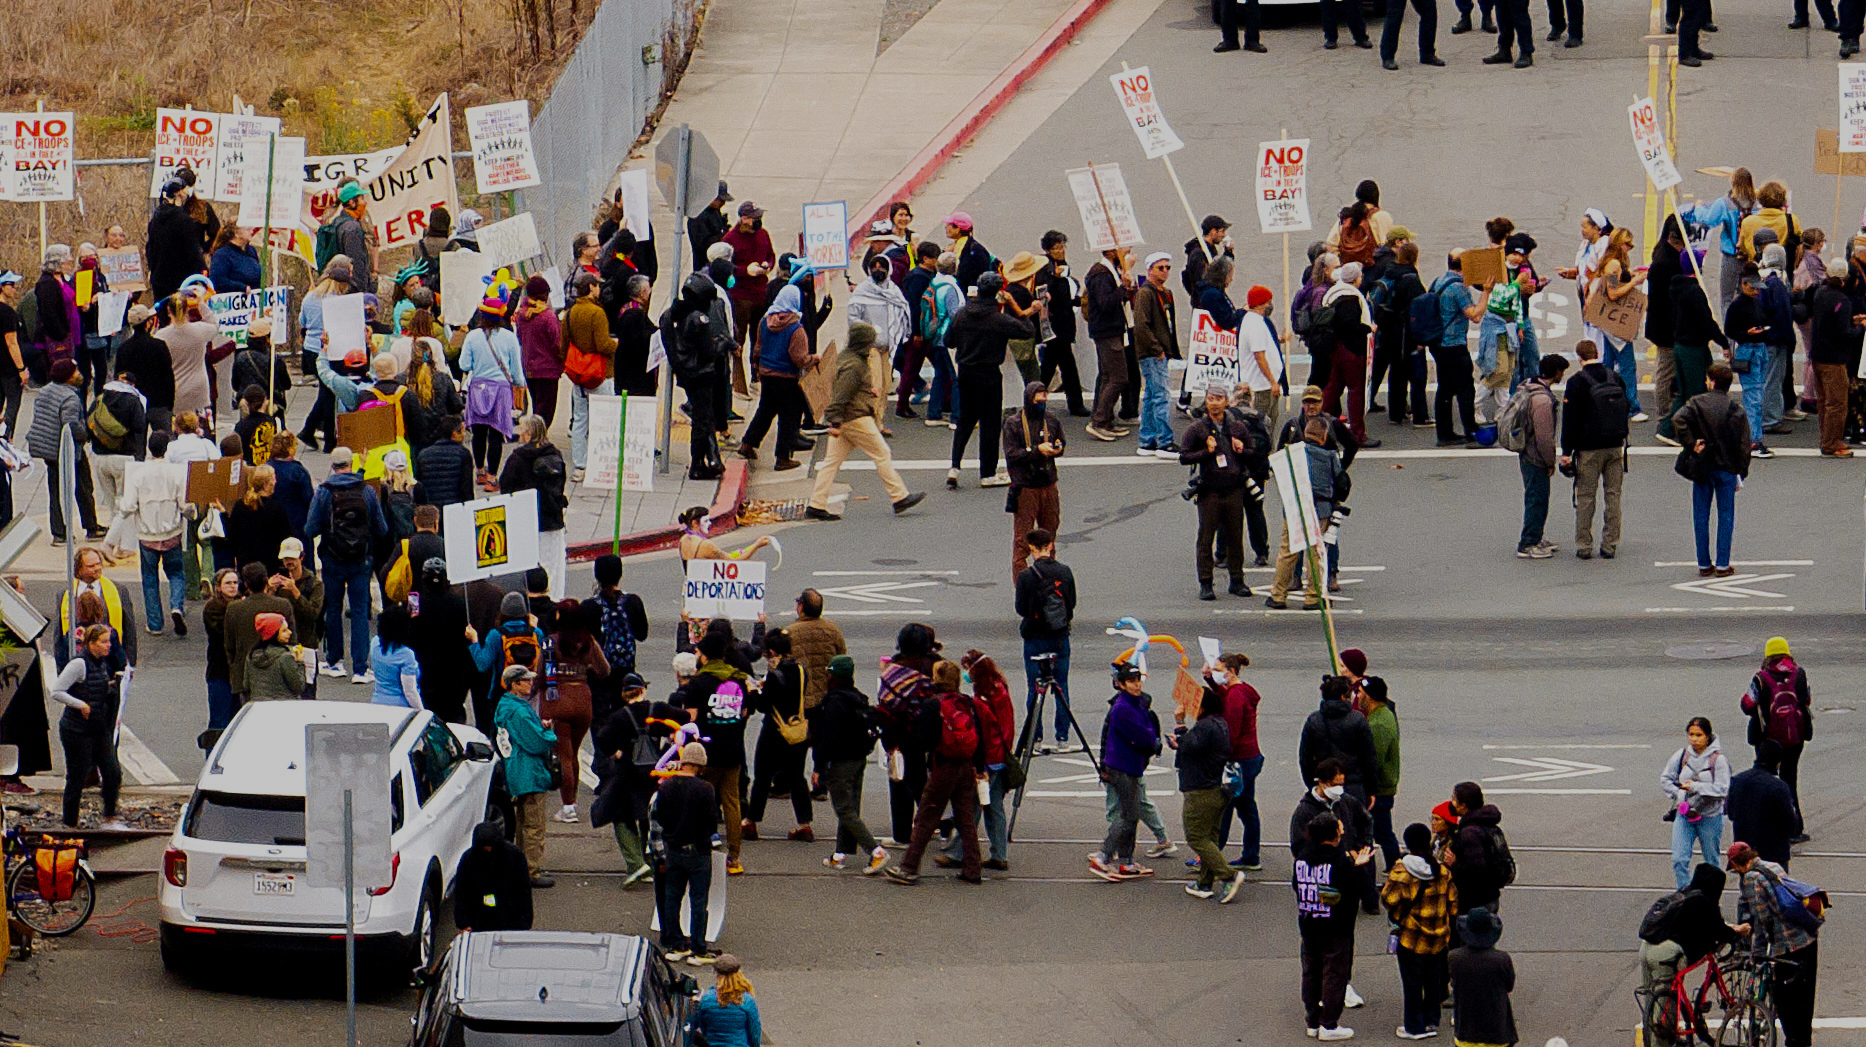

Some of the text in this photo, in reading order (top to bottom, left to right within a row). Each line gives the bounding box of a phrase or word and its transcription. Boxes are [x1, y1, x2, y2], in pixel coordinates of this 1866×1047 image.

[1119, 75, 1148, 96] NO
[1633, 105, 1653, 129] NO
[15, 120, 67, 138] NO
[161, 116, 212, 135] NO
[34, 137, 69, 149] TROOPS
[158, 134, 214, 147] ICE TROOPS
[160, 156, 211, 169] BAY!
[1264, 146, 1303, 165] NO
[15, 159, 67, 172] BAY!
[1260, 164, 1304, 178] ICE TROOPS
[1263, 187, 1302, 201] BAY!
[809, 206, 834, 219] ALL
[808, 231, 843, 242] TO THE
[1599, 302, 1629, 325] ICE
[1193, 331, 1208, 342] ICE
[1194, 354, 1239, 369] BAY
[713, 562, 738, 580] NO
[687, 581, 764, 600] DEPORTATIONS
